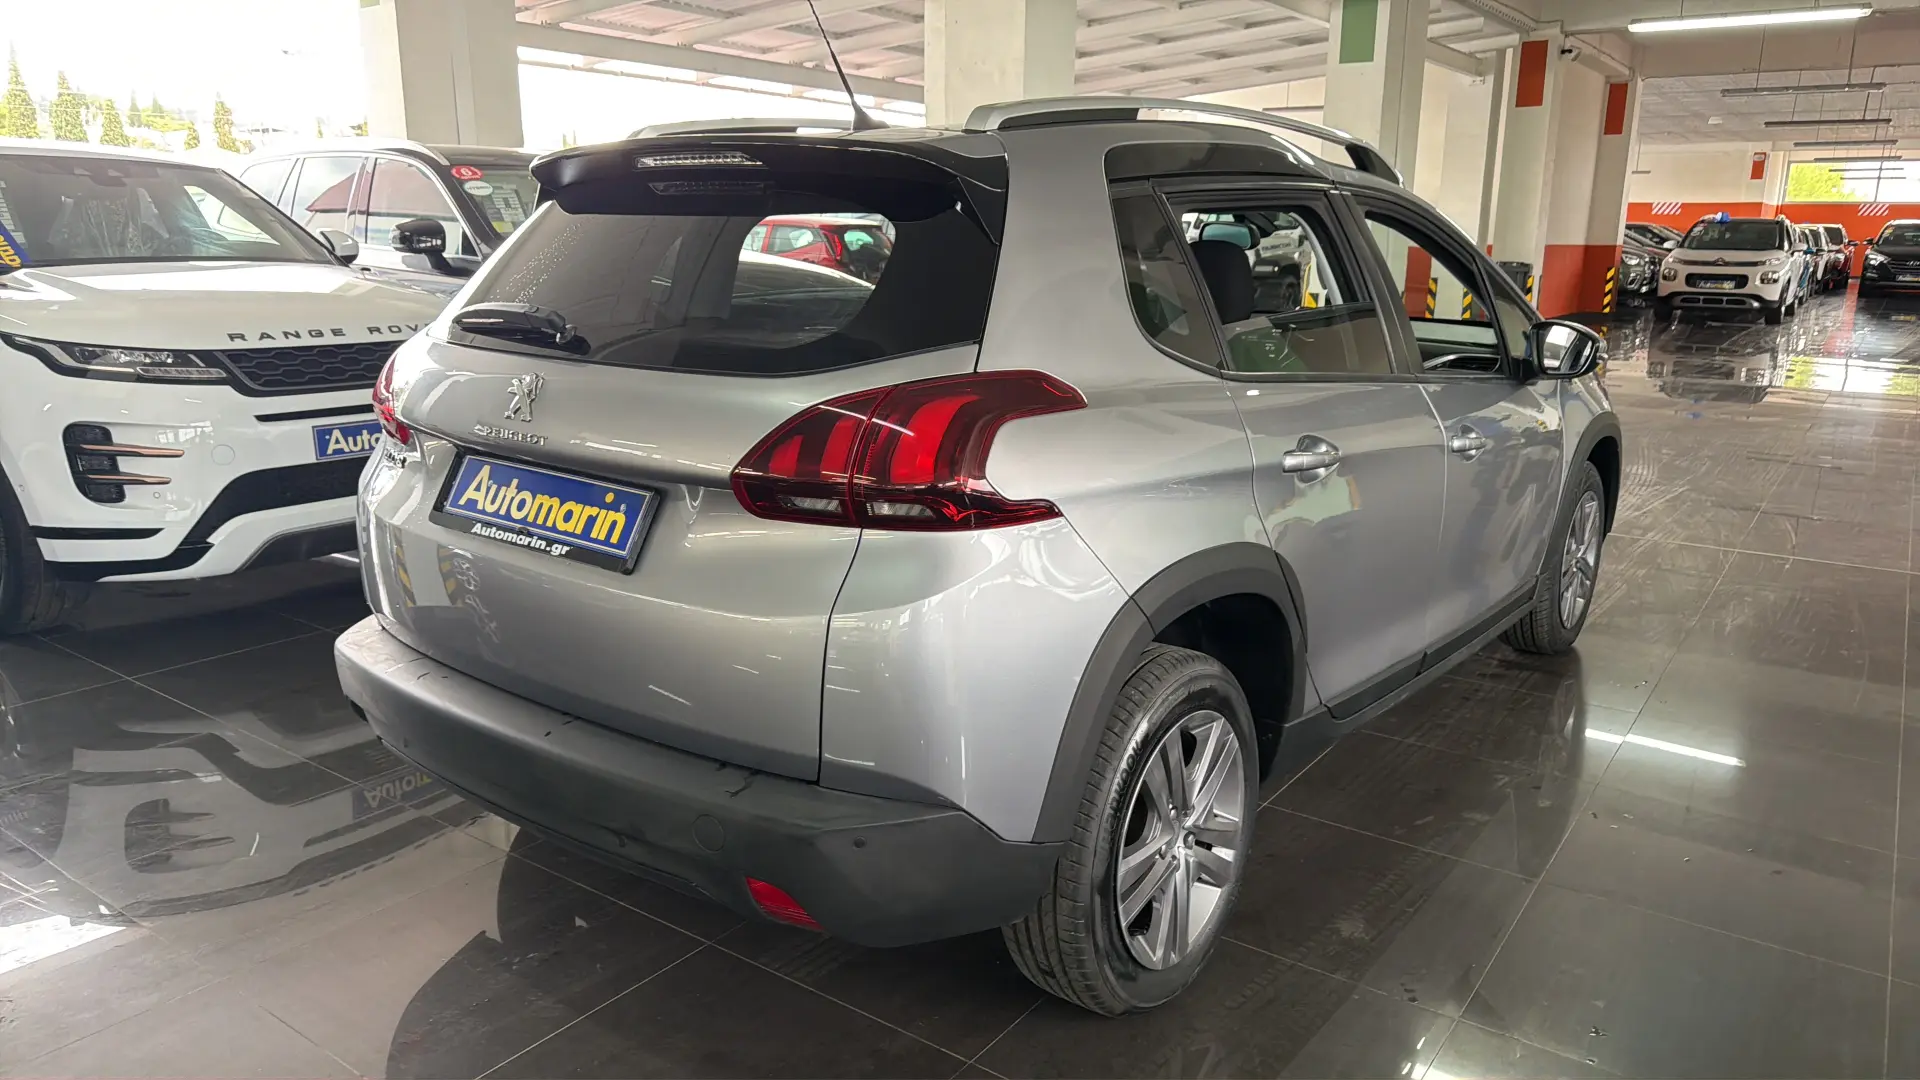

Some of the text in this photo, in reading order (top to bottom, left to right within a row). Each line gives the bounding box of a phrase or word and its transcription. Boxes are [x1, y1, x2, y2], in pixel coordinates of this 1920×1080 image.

[226, 323, 429, 343] RANGE ROV
[484, 425, 549, 446] PEUGEOT
[457, 464, 626, 544] Automarin
[471, 522, 571, 556] Automarin.gr
